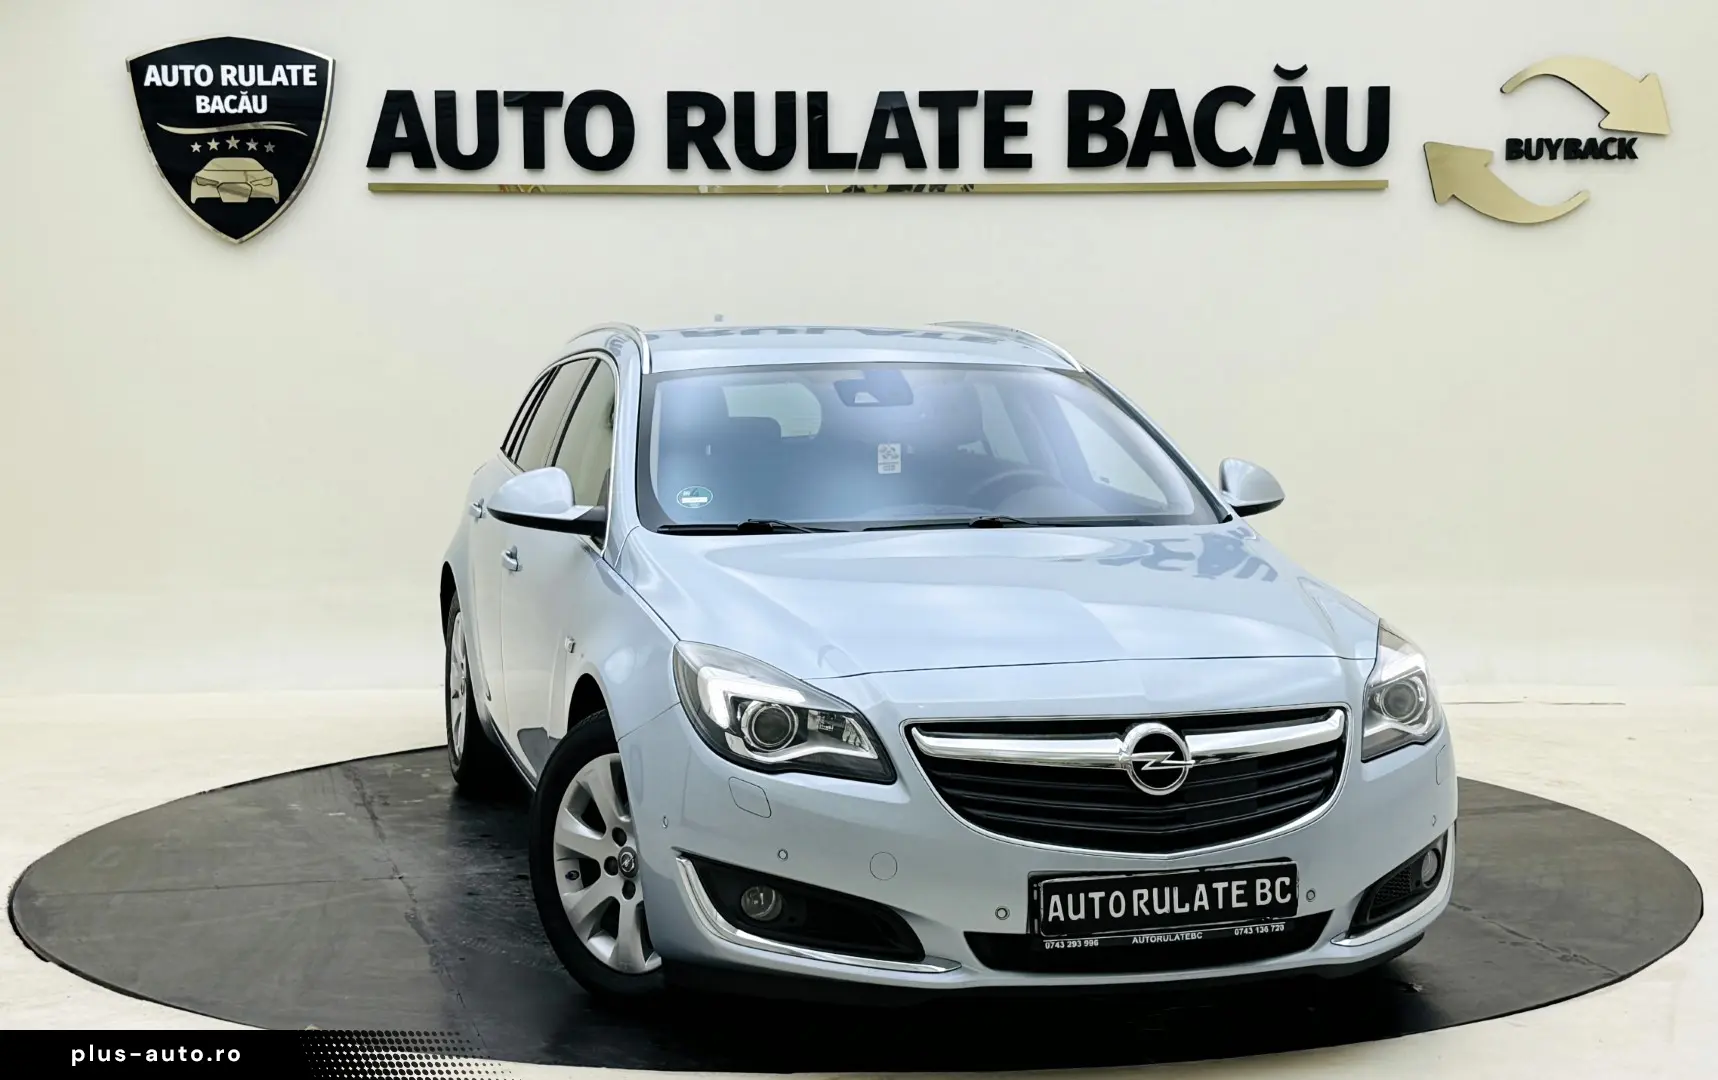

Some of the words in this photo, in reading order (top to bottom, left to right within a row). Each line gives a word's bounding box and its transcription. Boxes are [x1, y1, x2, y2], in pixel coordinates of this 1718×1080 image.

[144, 65, 214, 87] AUTO
[221, 65, 318, 87] RULATE
[196, 90, 268, 114] BACĂU
[366, 89, 635, 171] AUTO
[667, 90, 1033, 171] RULATE
[1067, 63, 1391, 169] BACĂU
[1505, 137, 1639, 161] BUYBACK
[1255, 877, 1292, 906] BC
[1132, 932, 1203, 945] AUTORULATEBC
[1234, 927, 1254, 936] 0743
[1045, 941, 1065, 950] 0743
[1066, 940, 1082, 948] 293
